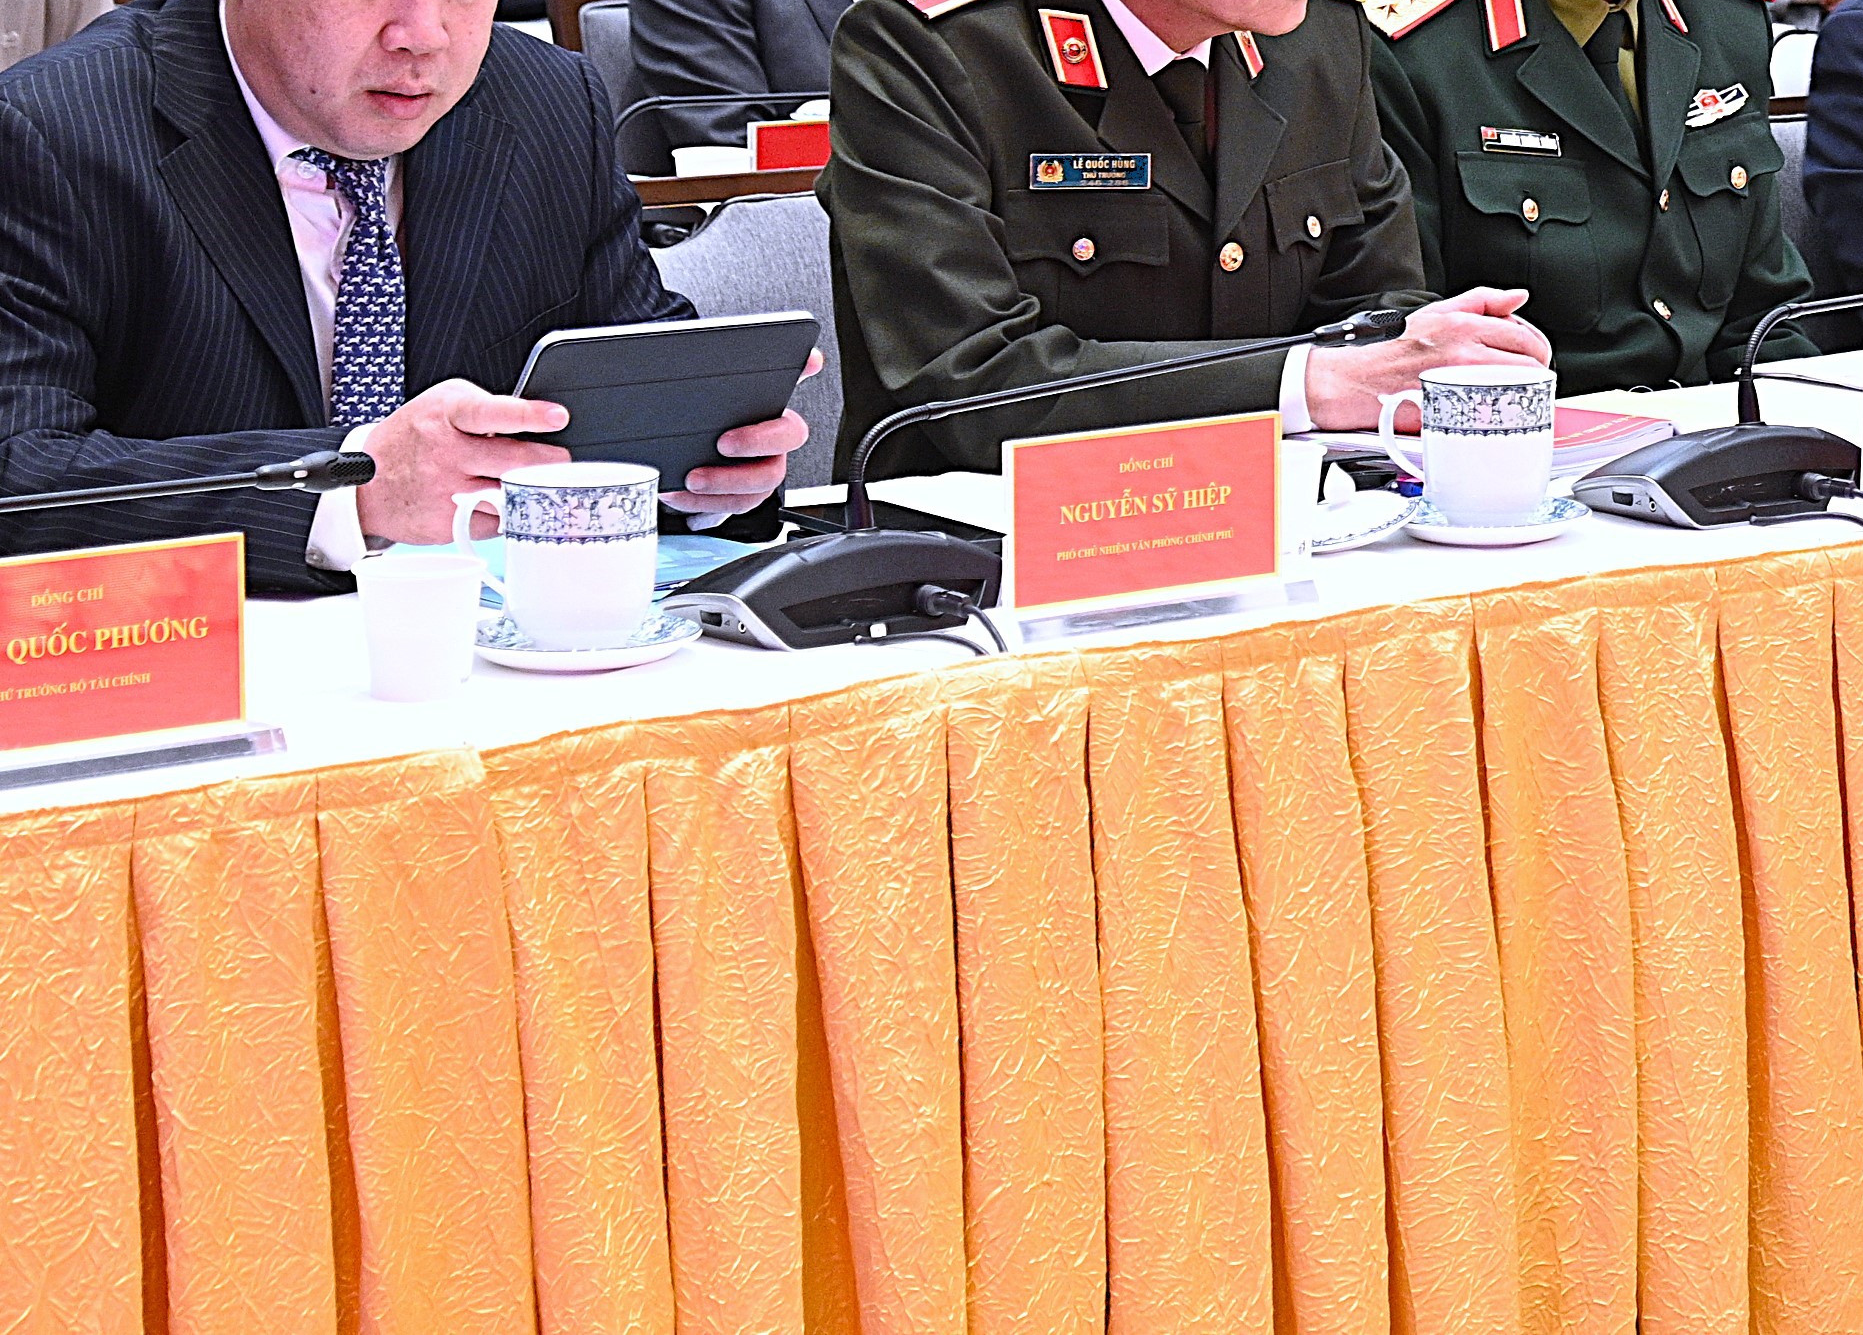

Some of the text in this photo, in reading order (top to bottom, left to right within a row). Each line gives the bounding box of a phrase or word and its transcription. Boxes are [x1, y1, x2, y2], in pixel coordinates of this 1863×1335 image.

[1119, 454, 1174, 473] ĐỒNG CHÍ
[1060, 482, 1232, 525] NGUYỄN SỸ HIỆP
[1056, 528, 1234, 561] PHÓ CHỦ NHIỆM VĂN PHÒNG CHÍNH PHỦ
[31, 584, 104, 607] ĐỒNG CHÍ
[6, 617, 209, 665] QUỐC PHƯƠNG
[0, 672, 151, 702] HỨ TRƯỞNG BỘ TÀI CHÍNH
